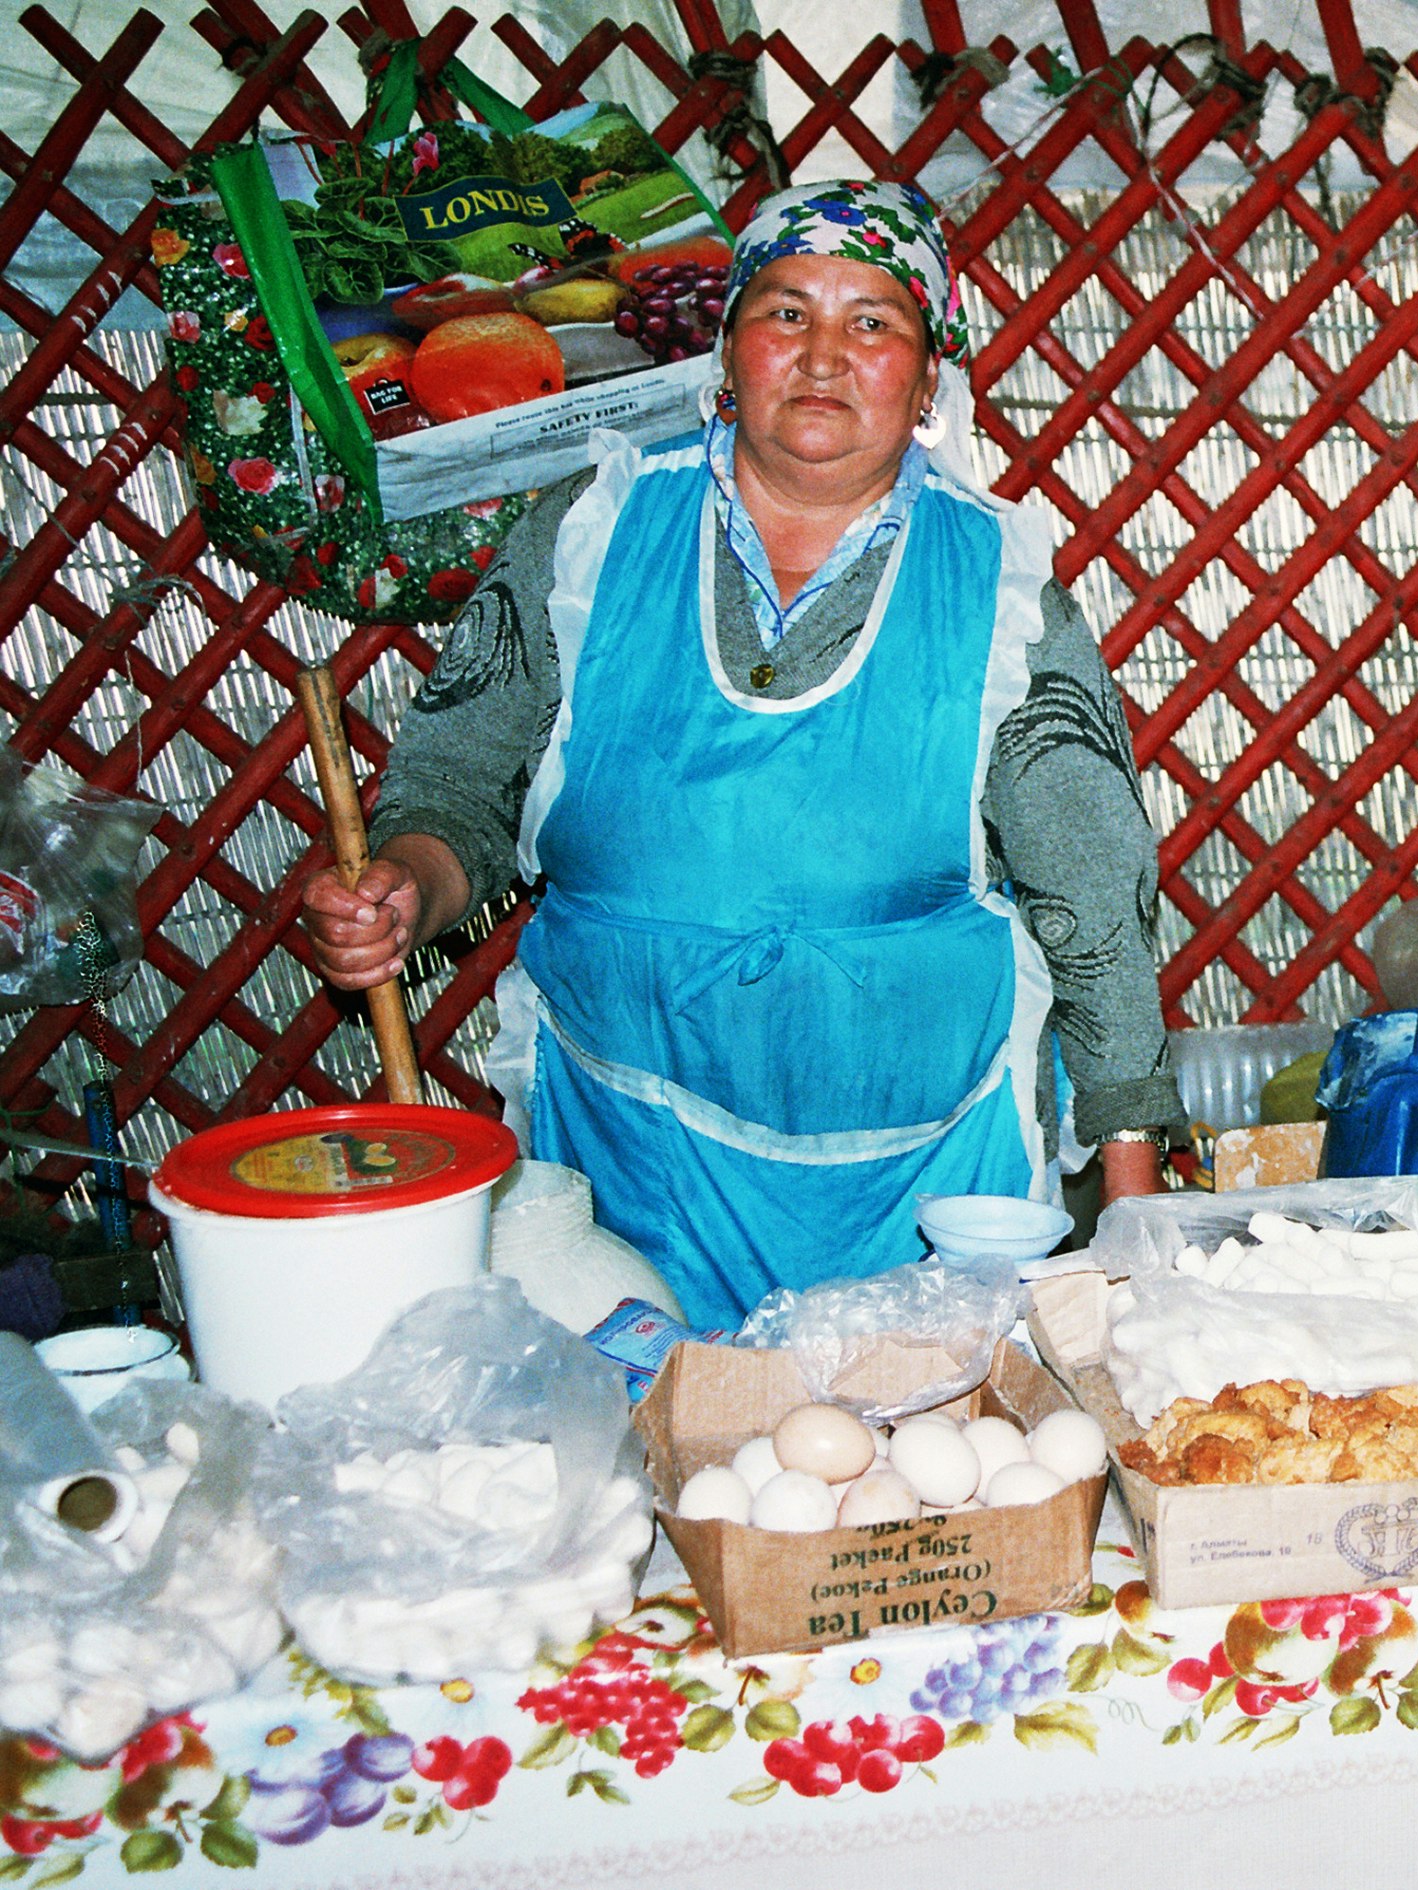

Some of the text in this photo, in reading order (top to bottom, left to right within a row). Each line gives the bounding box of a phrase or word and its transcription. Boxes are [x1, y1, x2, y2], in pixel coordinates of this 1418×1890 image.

[419, 188, 550, 230] LONDIS
[539, 412, 591, 433] SAFETY
[830, 1533, 972, 1570] 250g Packet
[810, 1558, 991, 1602] (Orange Pekoe)
[808, 1588, 998, 1639] Ceylon Tea
